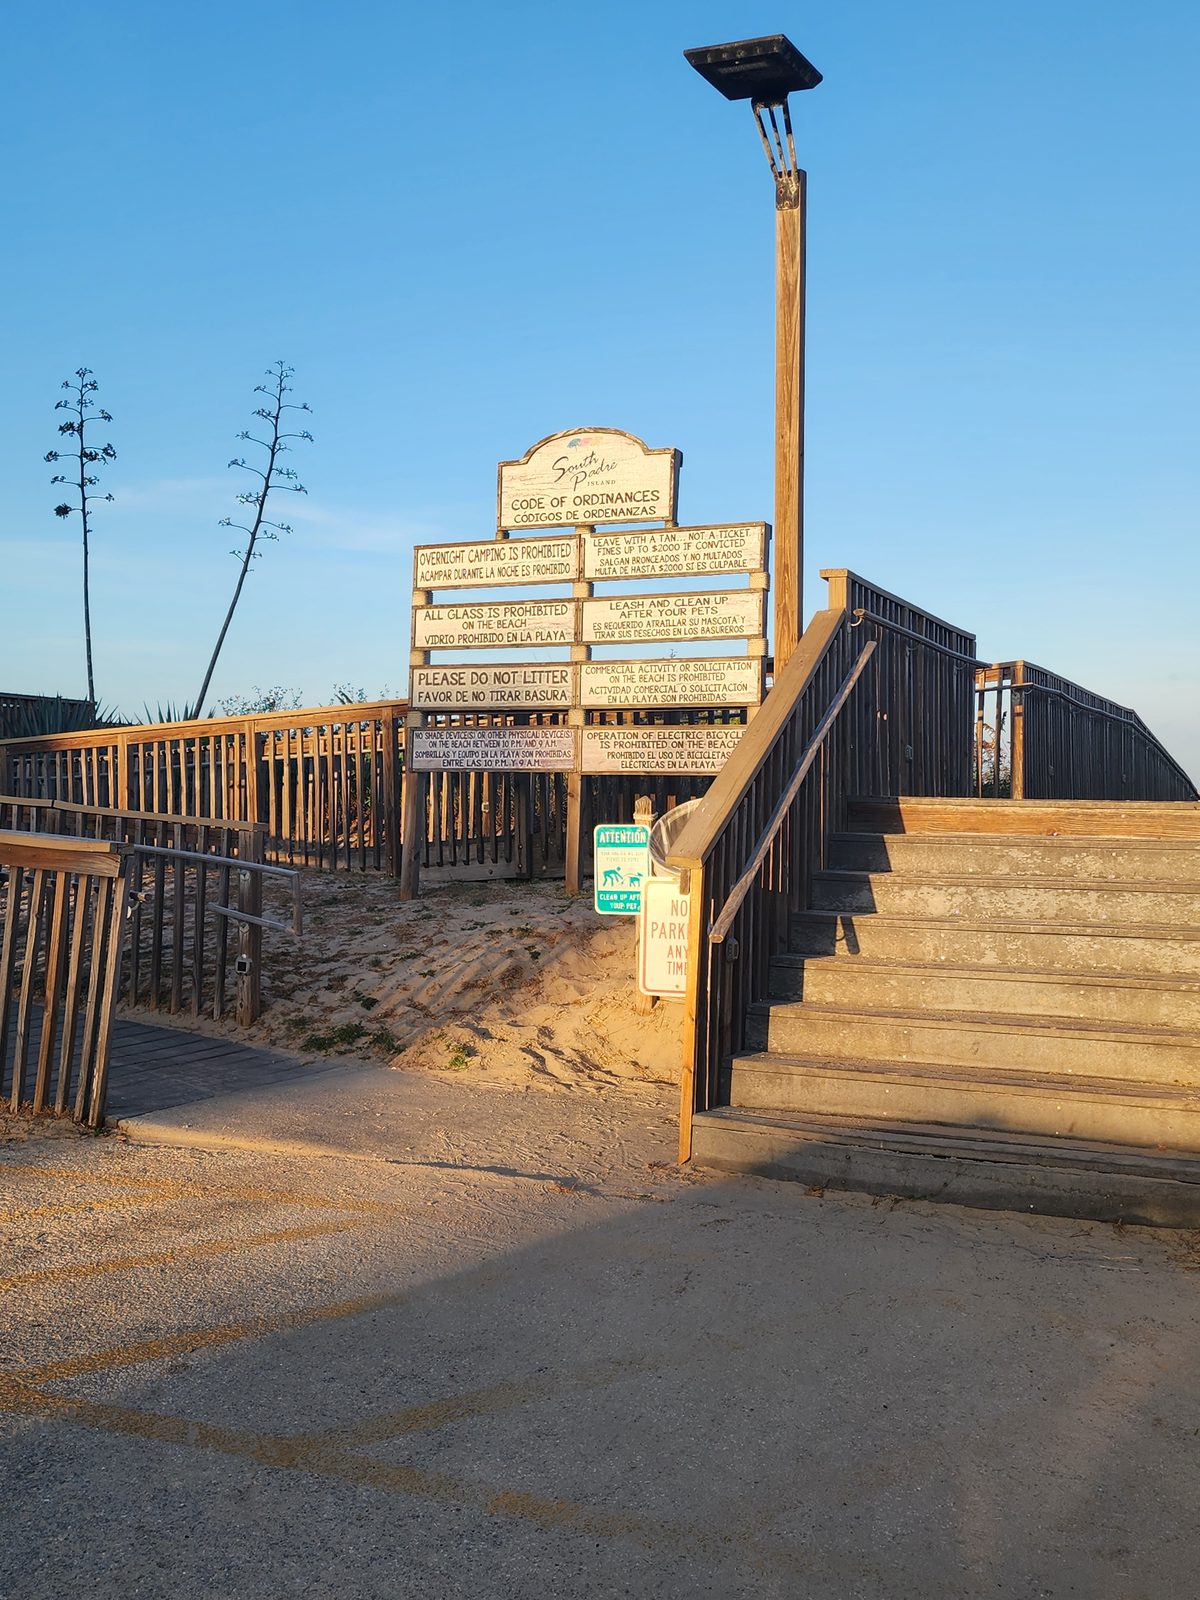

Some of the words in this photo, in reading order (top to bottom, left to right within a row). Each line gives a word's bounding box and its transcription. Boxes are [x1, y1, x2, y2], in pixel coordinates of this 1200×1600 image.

[552, 451, 598, 483] South
[570, 459, 617, 491] Padre
[512, 498, 545, 510] CODE
[551, 496, 567, 508] OF
[573, 490, 660, 506] ORDINANCES
[514, 510, 562, 523] CÓDIGOS
[566, 510, 579, 520] DE
[584, 506, 656, 518] ORDENANZAS
[594, 537, 620, 547] LEAVE
[624, 536, 646, 545] WITH
[689, 532, 706, 540] NOT
[709, 531, 715, 540] A
[598, 547, 621, 556] FINES
[625, 546, 634, 554] UP
[638, 545, 648, 553] TO
[652, 543, 680, 552] $2000
[696, 539, 745, 550] CONVICTED
[420, 550, 465, 566] OVERNIGHT
[468, 546, 506, 563] CAMPING
[509, 546, 518, 560] IS
[522, 543, 571, 559] PROHIBITED
[600, 557, 629, 567] SALGAN
[632, 555, 680, 565] BRONCEADOS
[691, 553, 700, 561] NO
[703, 550, 742, 560] MULTADOS
[420, 569, 451, 582] ACAMPAR
[454, 568, 483, 580] DURANTE
[486, 567, 495, 578] LA
[497, 565, 519, 577] NOCHE
[522, 565, 530, 576] ES
[533, 563, 570, 575] PROHIBIDO
[595, 567, 616, 575] MULTA
[620, 566, 628, 574] DE
[631, 564, 655, 573] HASTA
[710, 559, 747, 569] CULPABLE
[610, 601, 644, 610] LEASH
[649, 599, 670, 608] AND
[674, 597, 710, 606] CLEAN
[424, 610, 443, 621] ALL
[448, 608, 483, 619] GLASS
[488, 607, 500, 618] IS
[504, 604, 568, 617] PROHIBITED
[620, 609, 653, 618] AFTER
[658, 608, 687, 616] YOUR
[691, 607, 718, 615] PETS
[462, 621, 475, 630] ON
[478, 620, 492, 629] THE
[497, 619, 526, 628] BEACH
[593, 622, 601, 630] ES
[604, 621, 643, 630] REQUERIDO
[646, 619, 686, 628] ATRAILLAR
[689, 618, 699, 626] SU
[702, 616, 737, 625] MASCOTA
[425, 635, 454, 645] VIDRIO
[458, 632, 503, 644] PROHIBIDO
[507, 632, 518, 642] EN
[520, 632, 532, 642] LA
[536, 630, 566, 641] PLAYA
[594, 630, 615, 639] TIRAR
[618, 629, 631, 637] SUS
[634, 626, 670, 637] DESECHOS
[673, 626, 681, 635] EN
[684, 626, 698, 635] LOS
[701, 625, 744, 635] BASUREROS
[585, 666, 635, 675] COMMERCIAL
[639, 664, 676, 673] ACTIVITY
[680, 664, 690, 672] OR
[693, 662, 752, 671] SOLICITATION
[418, 672, 465, 686] PLEASE
[471, 671, 488, 685] DO
[493, 671, 518, 684] NOT
[523, 670, 568, 684] LITTER
[609, 675, 620, 683] ON
[623, 675, 636, 683] THE
[639, 674, 664, 682] BEACH
[667, 673, 676, 682] IS
[679, 673, 726, 681] PROHIBITED
[589, 686, 631, 694] ACTIVIDAD
[634, 684, 678, 693] COMERCIAL
[681, 684, 687, 692] O
[690, 681, 747, 692] SOLICITACIÓN
[418, 691, 452, 702] FAVOR
[456, 691, 468, 701] DE
[472, 691, 485, 701] NO
[490, 690, 521, 701] TIRAR
[525, 689, 567, 700] BASURA
[608, 695, 617, 703] EN
[619, 695, 629, 703] LA
[632, 694, 658, 702] PLAYA
[661, 694, 676, 702] SON
[679, 693, 726, 701] PROHIBIDAS
[425, 731, 444, 739] SHADE
[446, 731, 476, 739] DEVICE(S)
[478, 731, 485, 739] OR
[488, 731, 506, 739] OTHER
[509, 731, 540, 739] PHYSICAL
[541, 730, 572, 739] DEVICE(S)
[587, 732, 639, 740] OPERATION
[642, 732, 654, 740] OF
[658, 731, 702, 740] ELECTRIC
[439, 740, 449, 748] THE
[451, 740, 470, 748] BEACH
[473, 740, 500, 748] BETWEEN
[614, 740, 667, 749] PROHIBITED
[671, 740, 684, 748] ON
[687, 740, 704, 748] THE
[708, 740, 740, 748] BEACH
[535, 750, 571, 758] PROHIBIDAS
[607, 751, 645, 759] PROHIBIDO
[687, 751, 731, 759] BICICLETAS
[467, 759, 481, 767] LAS
[691, 761, 716, 769] PLAYA
[671, 900, 687, 917] NO
